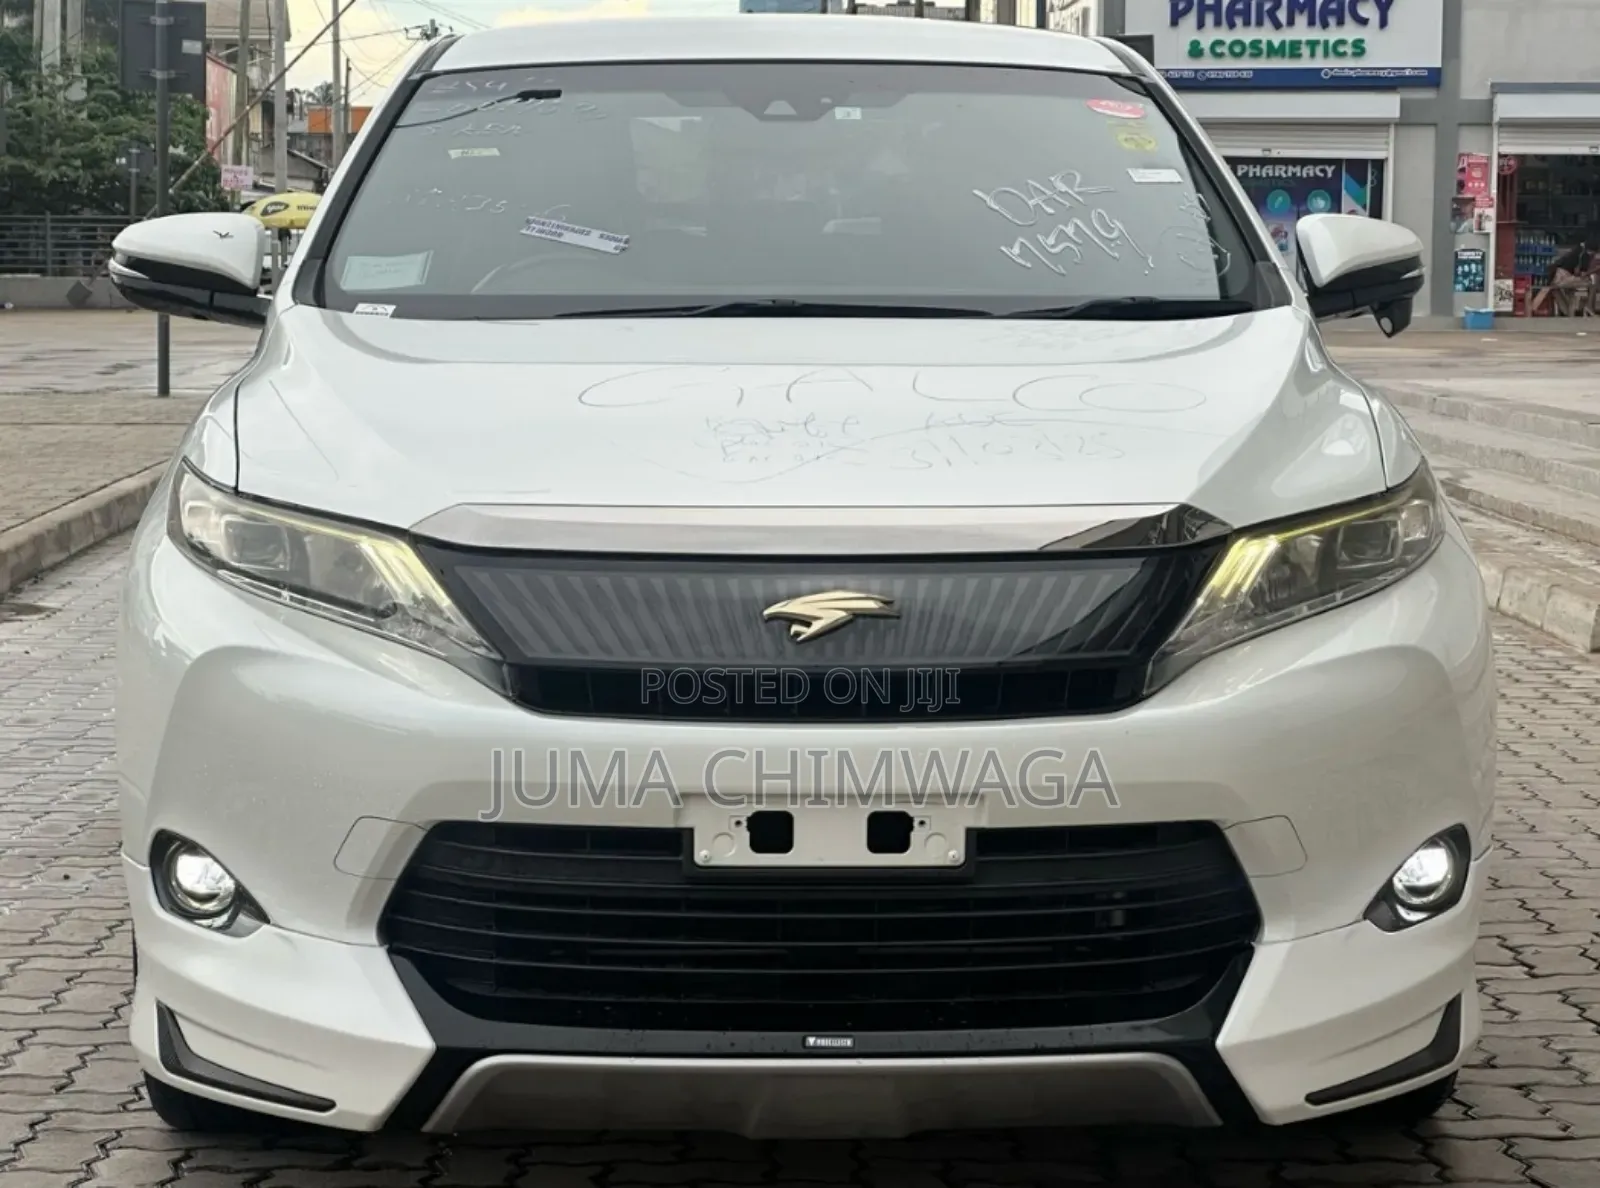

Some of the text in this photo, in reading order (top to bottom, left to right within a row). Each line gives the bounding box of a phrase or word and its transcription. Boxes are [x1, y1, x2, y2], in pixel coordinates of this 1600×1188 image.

[1169, 0, 1395, 30] PHARMACY
[1188, 38, 1367, 58] & COSMETICS
[1236, 164, 1336, 178] PHARMACY
